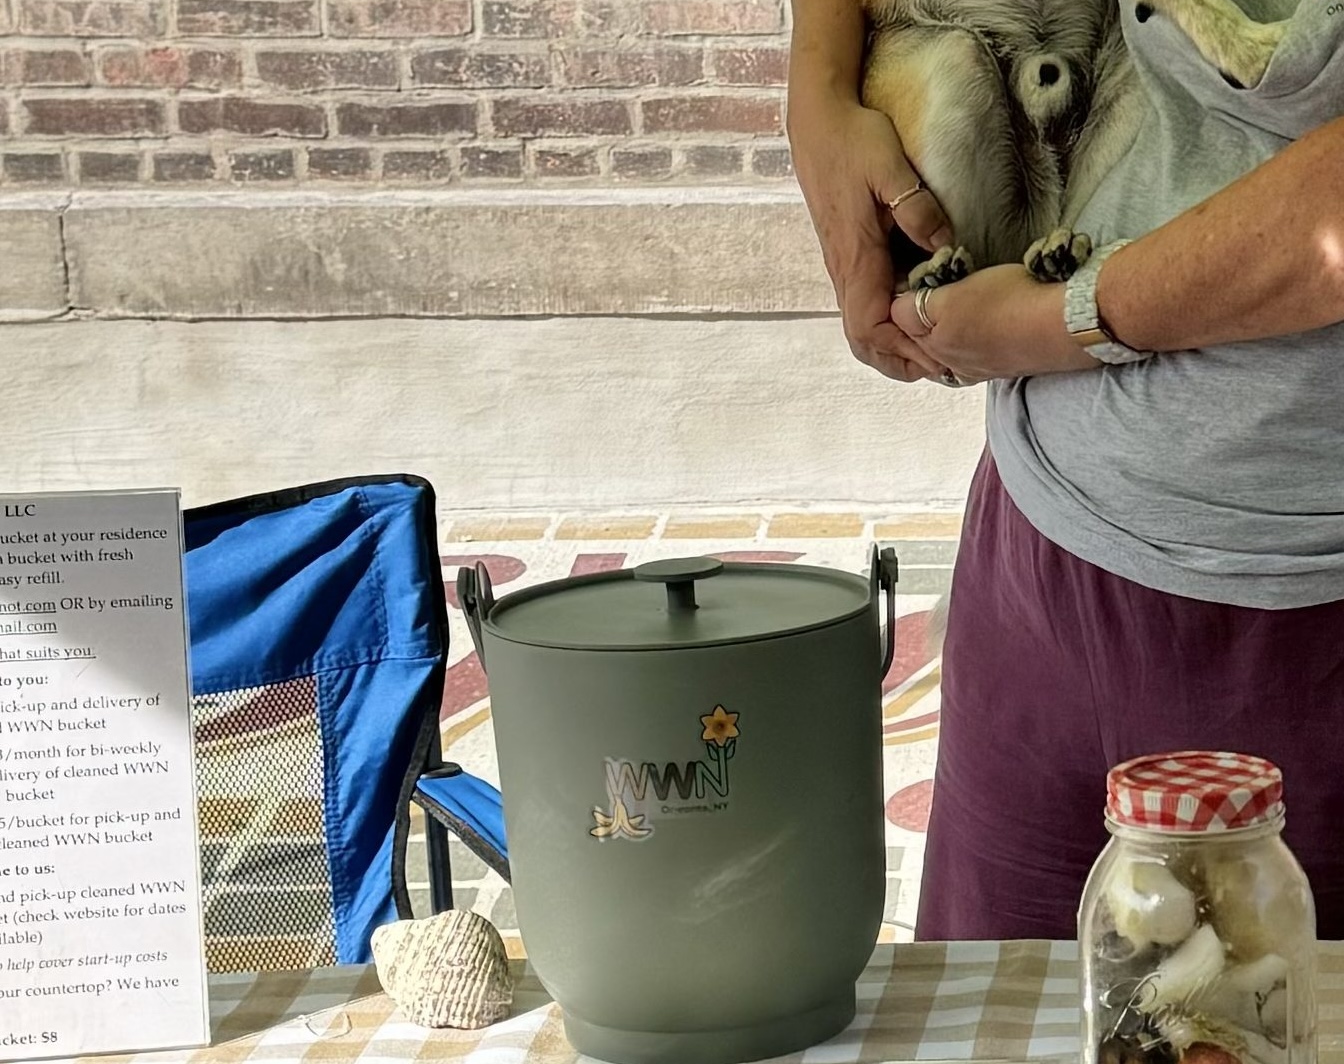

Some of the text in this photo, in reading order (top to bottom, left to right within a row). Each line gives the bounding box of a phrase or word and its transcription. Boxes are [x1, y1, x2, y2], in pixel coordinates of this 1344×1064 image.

[5, 504, 37, 517] LLC
[43, 531, 57, 543] at
[61, 532, 95, 546] your
[100, 527, 168, 541] residence
[8, 551, 56, 565] bucket
[61, 549, 94, 562] with
[98, 547, 134, 561] fresh
[27, 571, 65, 585] refill.
[60, 597, 84, 610] OR
[88, 596, 106, 612] by
[110, 594, 174, 610] emailing
[26, 646, 60, 659] suits
[16, 675, 49, 689] you:
[0, 693, 161, 715] ick-up and delivery of
[7, 720, 53, 733] WWN
[58, 717, 107, 731] bucket
[66, 744, 87, 757] for
[91, 741, 162, 756] bi-weekly
[45, 766, 60, 779] of
[64, 763, 119, 778] cleaned
[124, 760, 169, 774] WWN
[6, 788, 55, 802] bucket
[70, 813, 90, 825] for
[95, 810, 150, 828] pick-up
[154, 808, 181, 821] and
[54, 832, 100, 845] WWN
[105, 830, 153, 844] bucket
[15, 865, 29, 876] to
[34, 864, 55, 875] us:
[20, 889, 76, 907] pick-up
[80, 883, 135, 899] cleaned
[140, 880, 185, 894] WWN
[13, 909, 60, 926] (check
[64, 906, 120, 920] website
[124, 904, 145, 917] for
[148, 903, 187, 915] dates
[7, 957, 35, 973] help
[38, 957, 74, 970] cover
[77, 952, 132, 967] start-up
[136, 950, 169, 963] costs
[25, 979, 112, 996] countertop?
[117, 978, 141, 990] We
[145, 976, 180, 989] have
